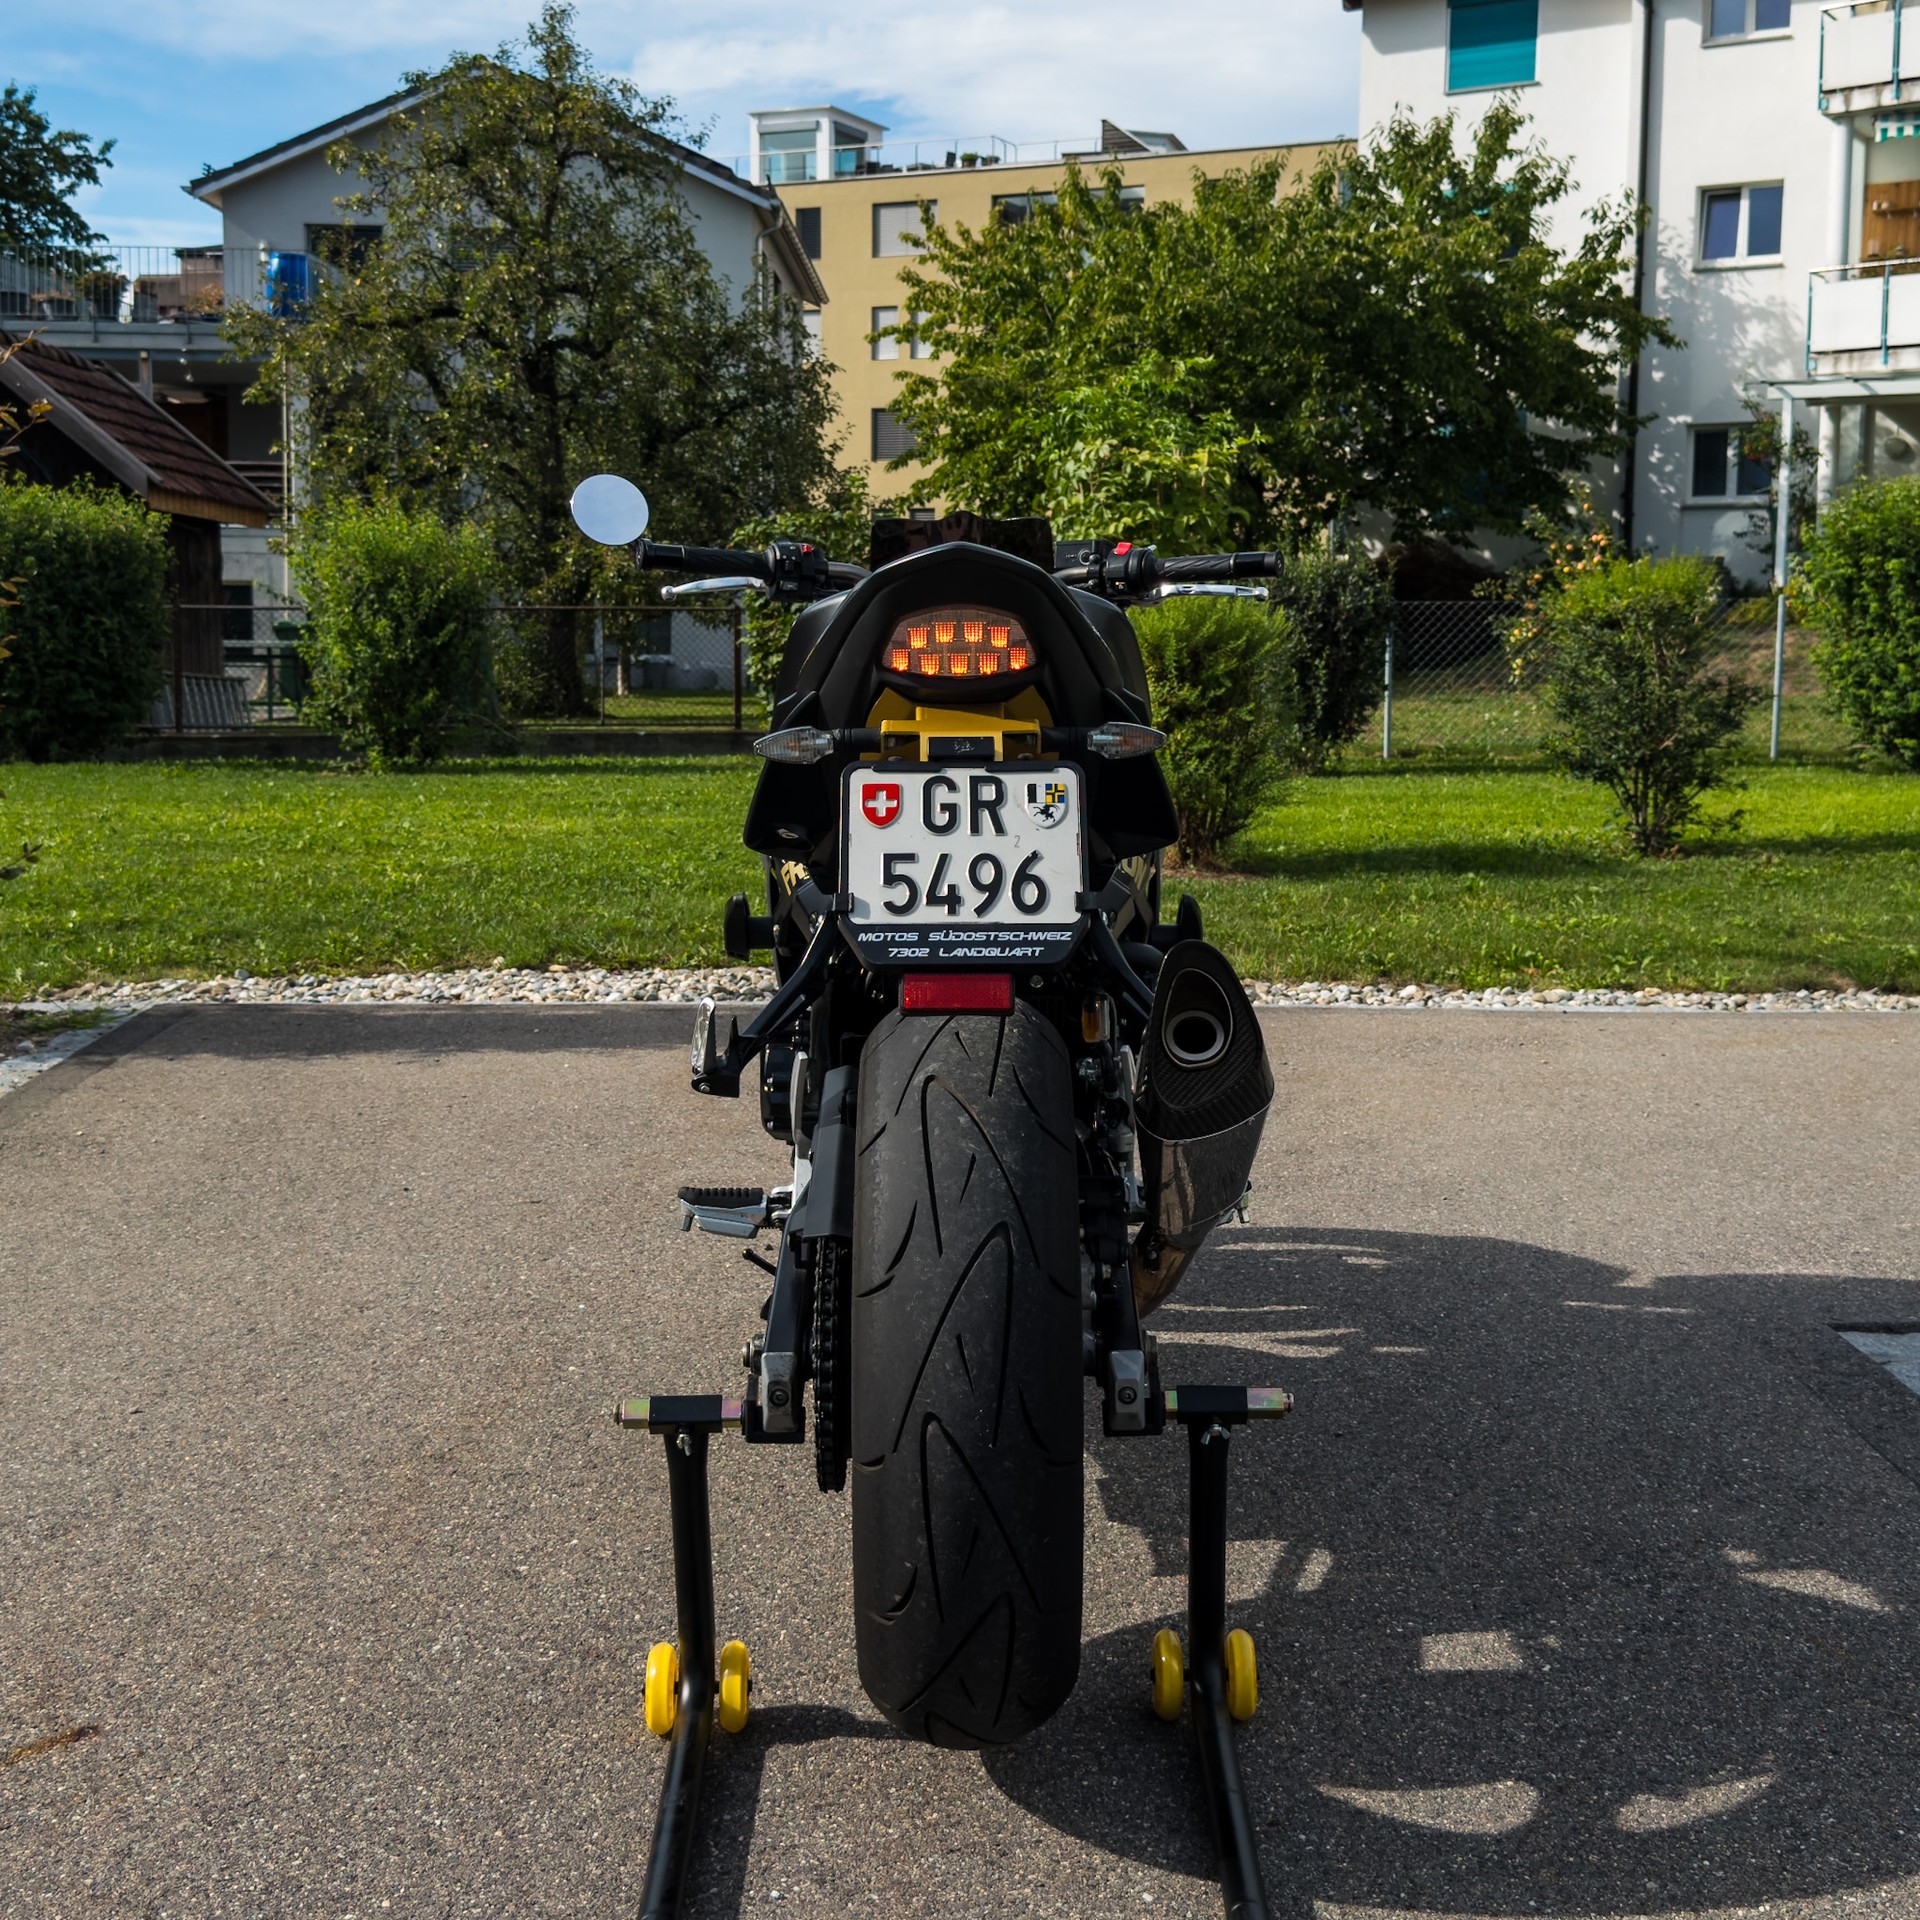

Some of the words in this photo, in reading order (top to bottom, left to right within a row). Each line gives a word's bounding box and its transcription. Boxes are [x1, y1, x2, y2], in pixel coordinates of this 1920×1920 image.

[921, 775, 1007, 836] GR
[881, 849, 1048, 917] 5496
[857, 932, 919, 942] MOTOS
[928, 930, 1073, 941] SÜDOSTSCHWEIZ
[888, 948, 930, 957] 7302
[939, 947, 1044, 957] LANDQUART
